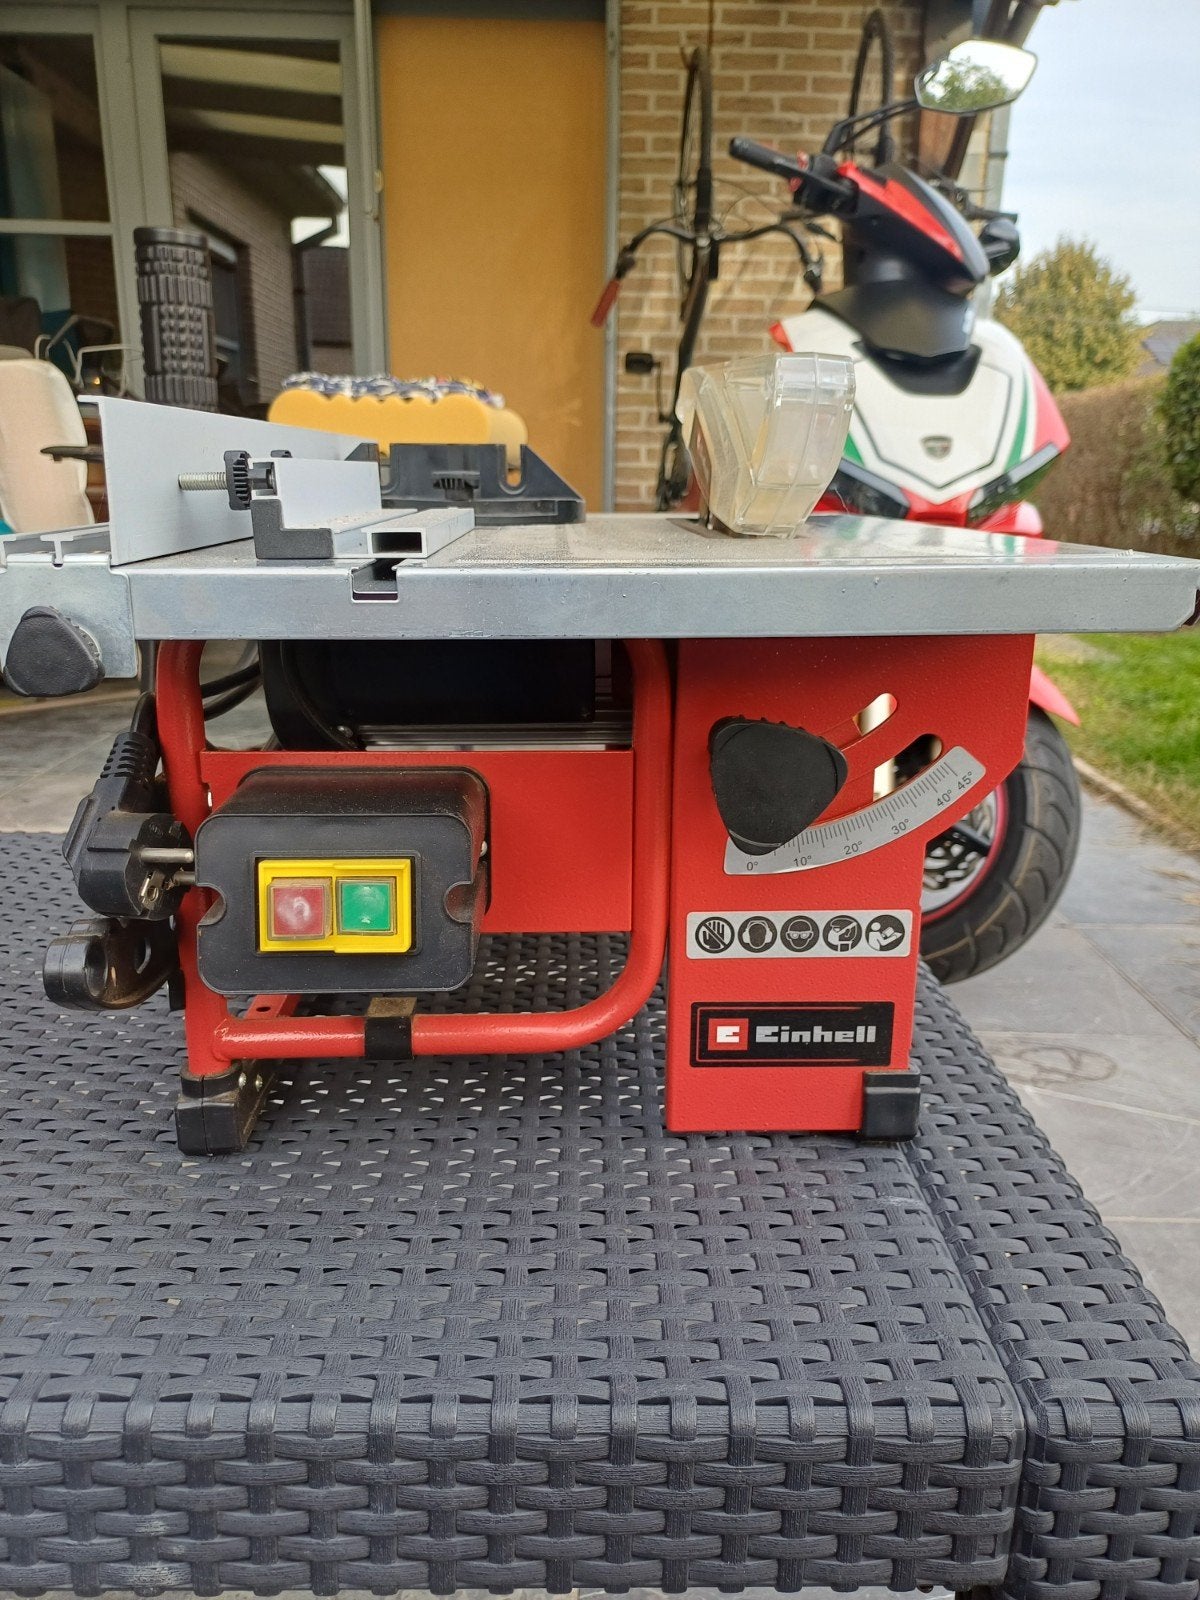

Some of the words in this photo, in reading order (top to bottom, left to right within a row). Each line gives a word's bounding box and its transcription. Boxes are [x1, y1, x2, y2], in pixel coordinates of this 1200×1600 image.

[793, 855, 812, 867] 10°
[843, 841, 863, 855] 20°
[891, 818, 910, 835] 30°
[936, 789, 953, 807] 40°
[957, 771, 974, 791] 45°
[755, 1026, 876, 1043] Einhell
